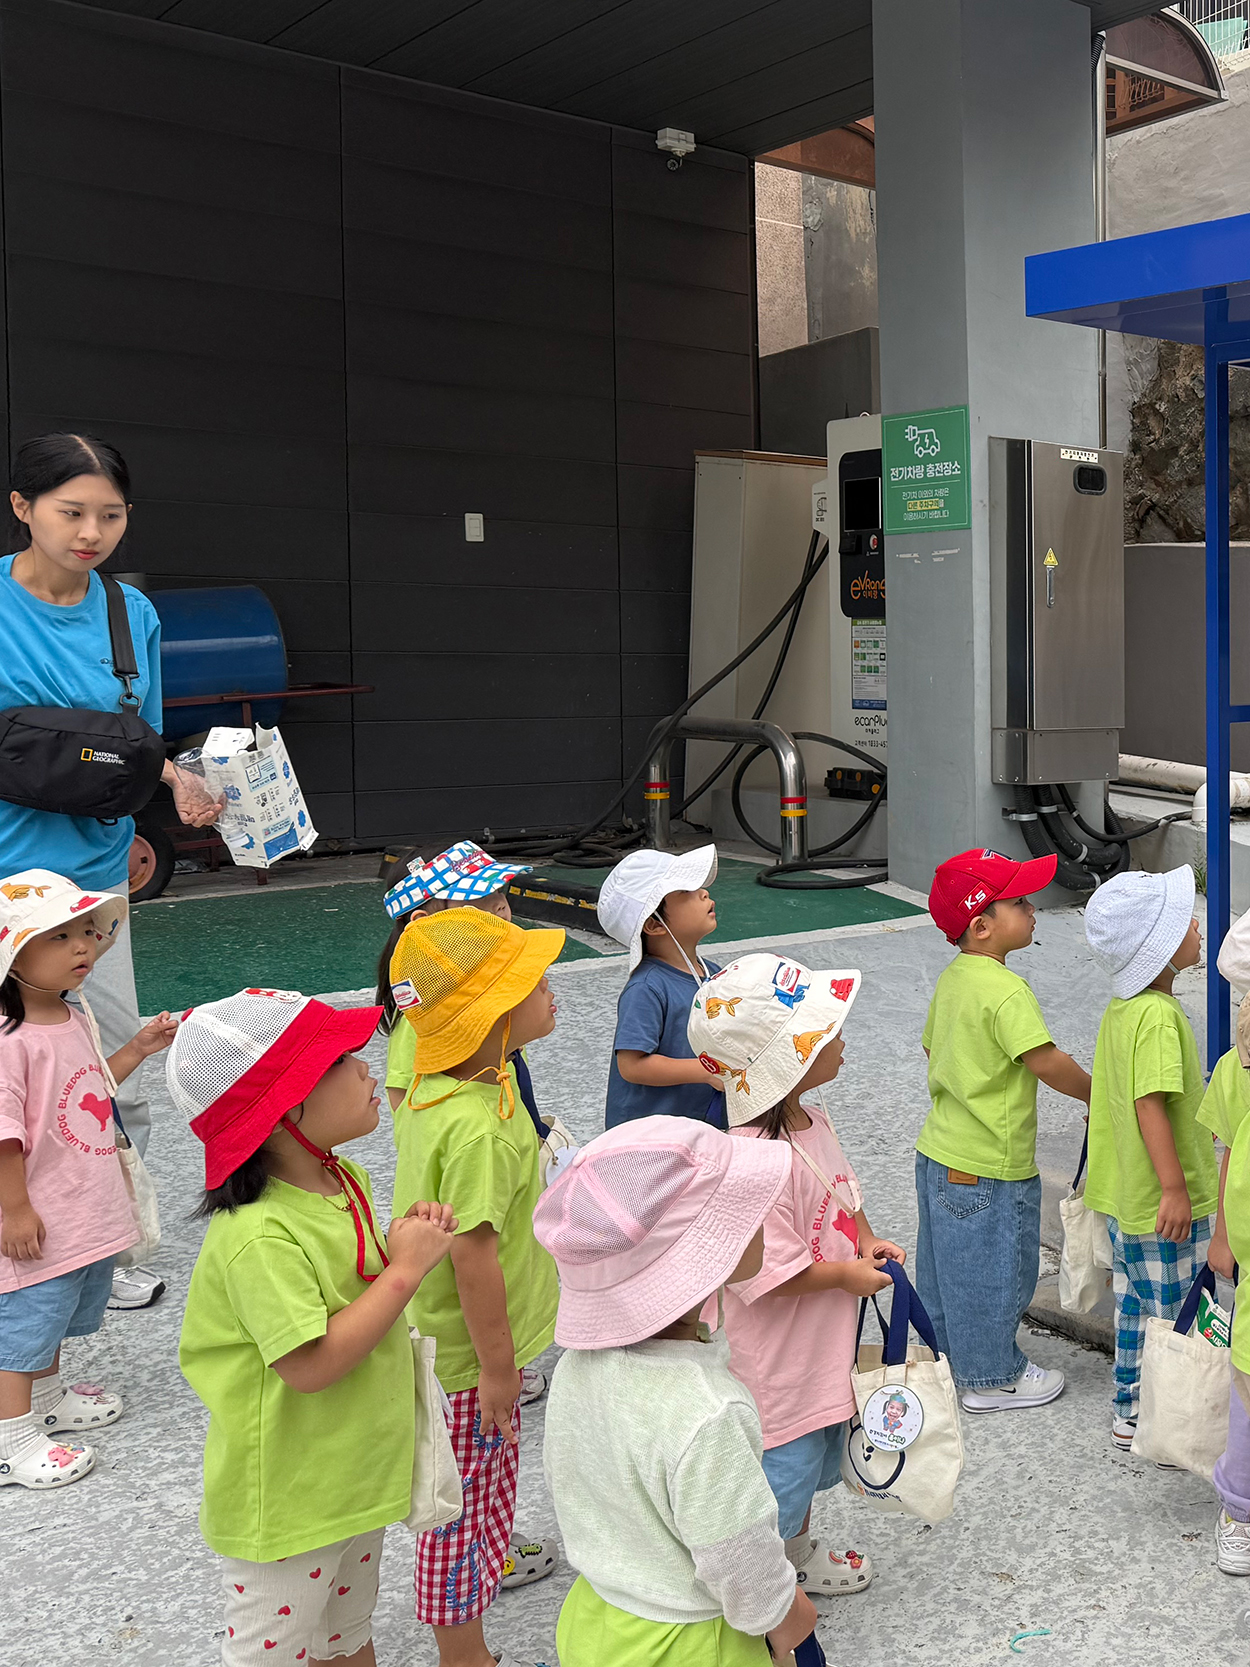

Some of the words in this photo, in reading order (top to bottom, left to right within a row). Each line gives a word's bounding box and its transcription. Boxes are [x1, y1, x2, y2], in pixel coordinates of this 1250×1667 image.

[890, 464, 924, 482] 전기차량
[926, 460, 961, 478] 충전장소
[92, 756, 127, 766] GEOGRAPHIC
[93, 750, 120, 760] NATIONAL
[58, 1066, 87, 1110] BLUEDOG
[57, 1113, 91, 1154] BLUEDOG
[94, 1144, 118, 1156] EDOG
